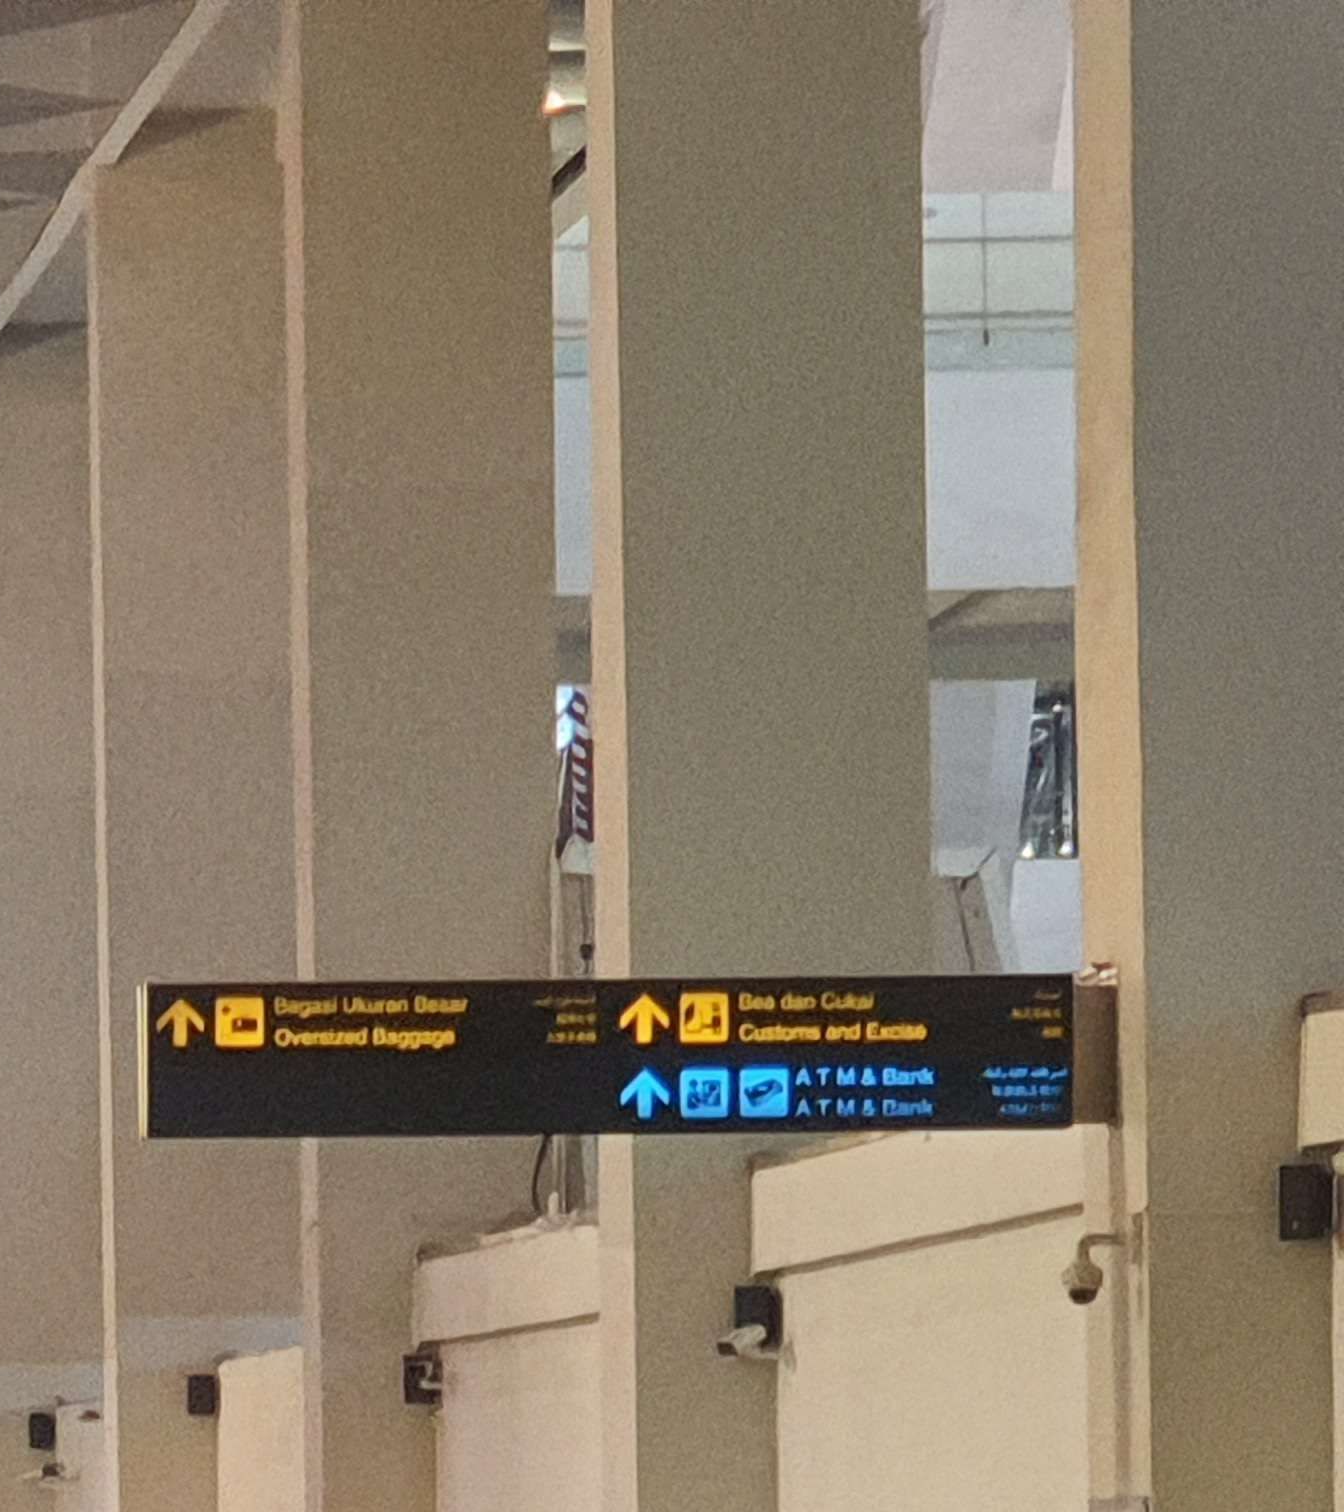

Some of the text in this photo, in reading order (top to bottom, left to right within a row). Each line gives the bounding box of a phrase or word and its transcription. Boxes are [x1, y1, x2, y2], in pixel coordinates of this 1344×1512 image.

[780, 992, 816, 1011] dan
[274, 1026, 456, 1049] Oversized Baggage
[739, 1022, 821, 1042] Customs
[825, 1022, 862, 1041] and
[882, 1066, 935, 1085] Bank
[882, 1098, 935, 1117] Bank
